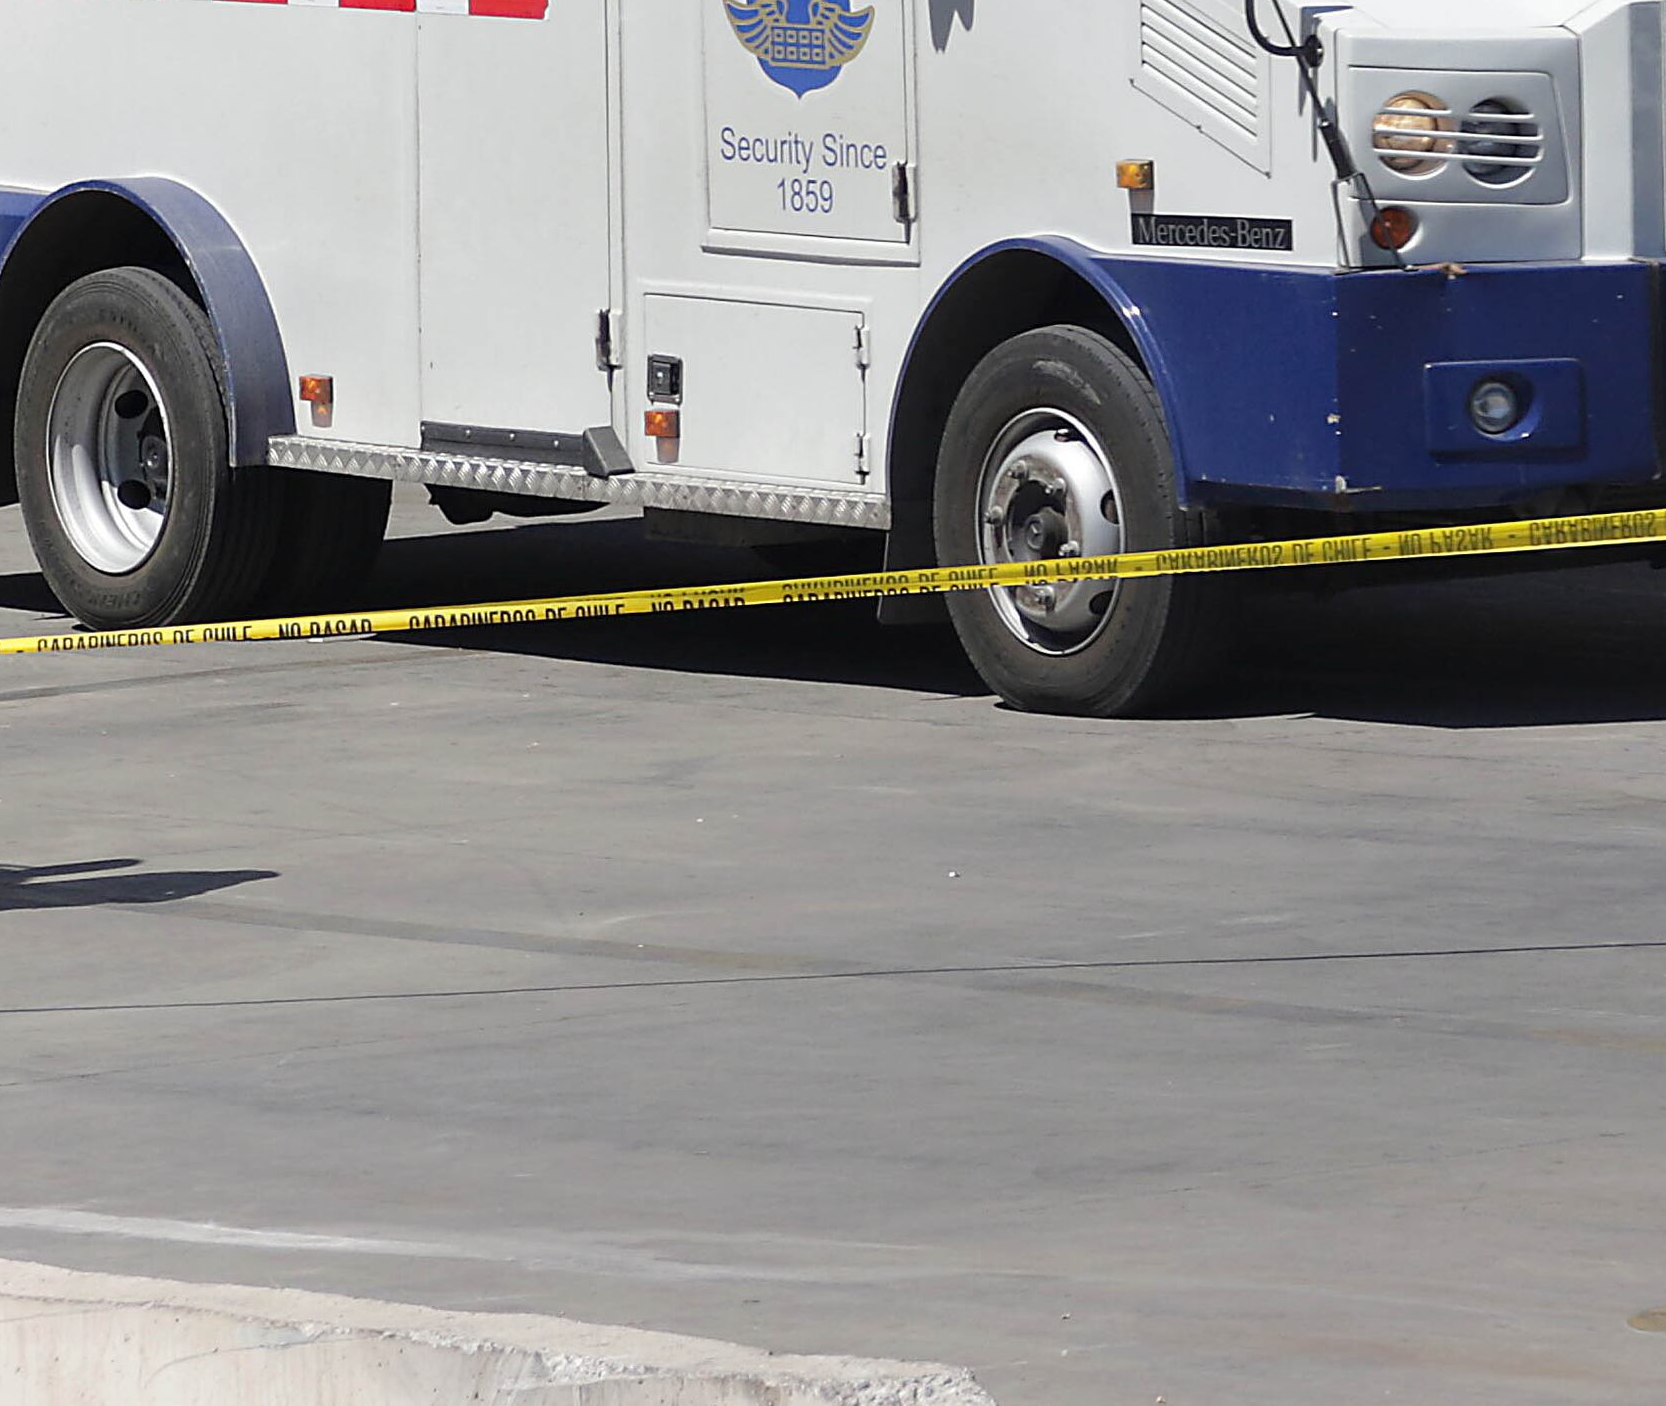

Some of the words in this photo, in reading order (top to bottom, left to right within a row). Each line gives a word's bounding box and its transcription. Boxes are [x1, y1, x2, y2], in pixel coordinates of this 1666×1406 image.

[721, 127, 813, 174] Security
[822, 133, 887, 169] Since
[778, 178, 833, 213] 1859
[1137, 216, 1286, 249] Mercedes-Benz
